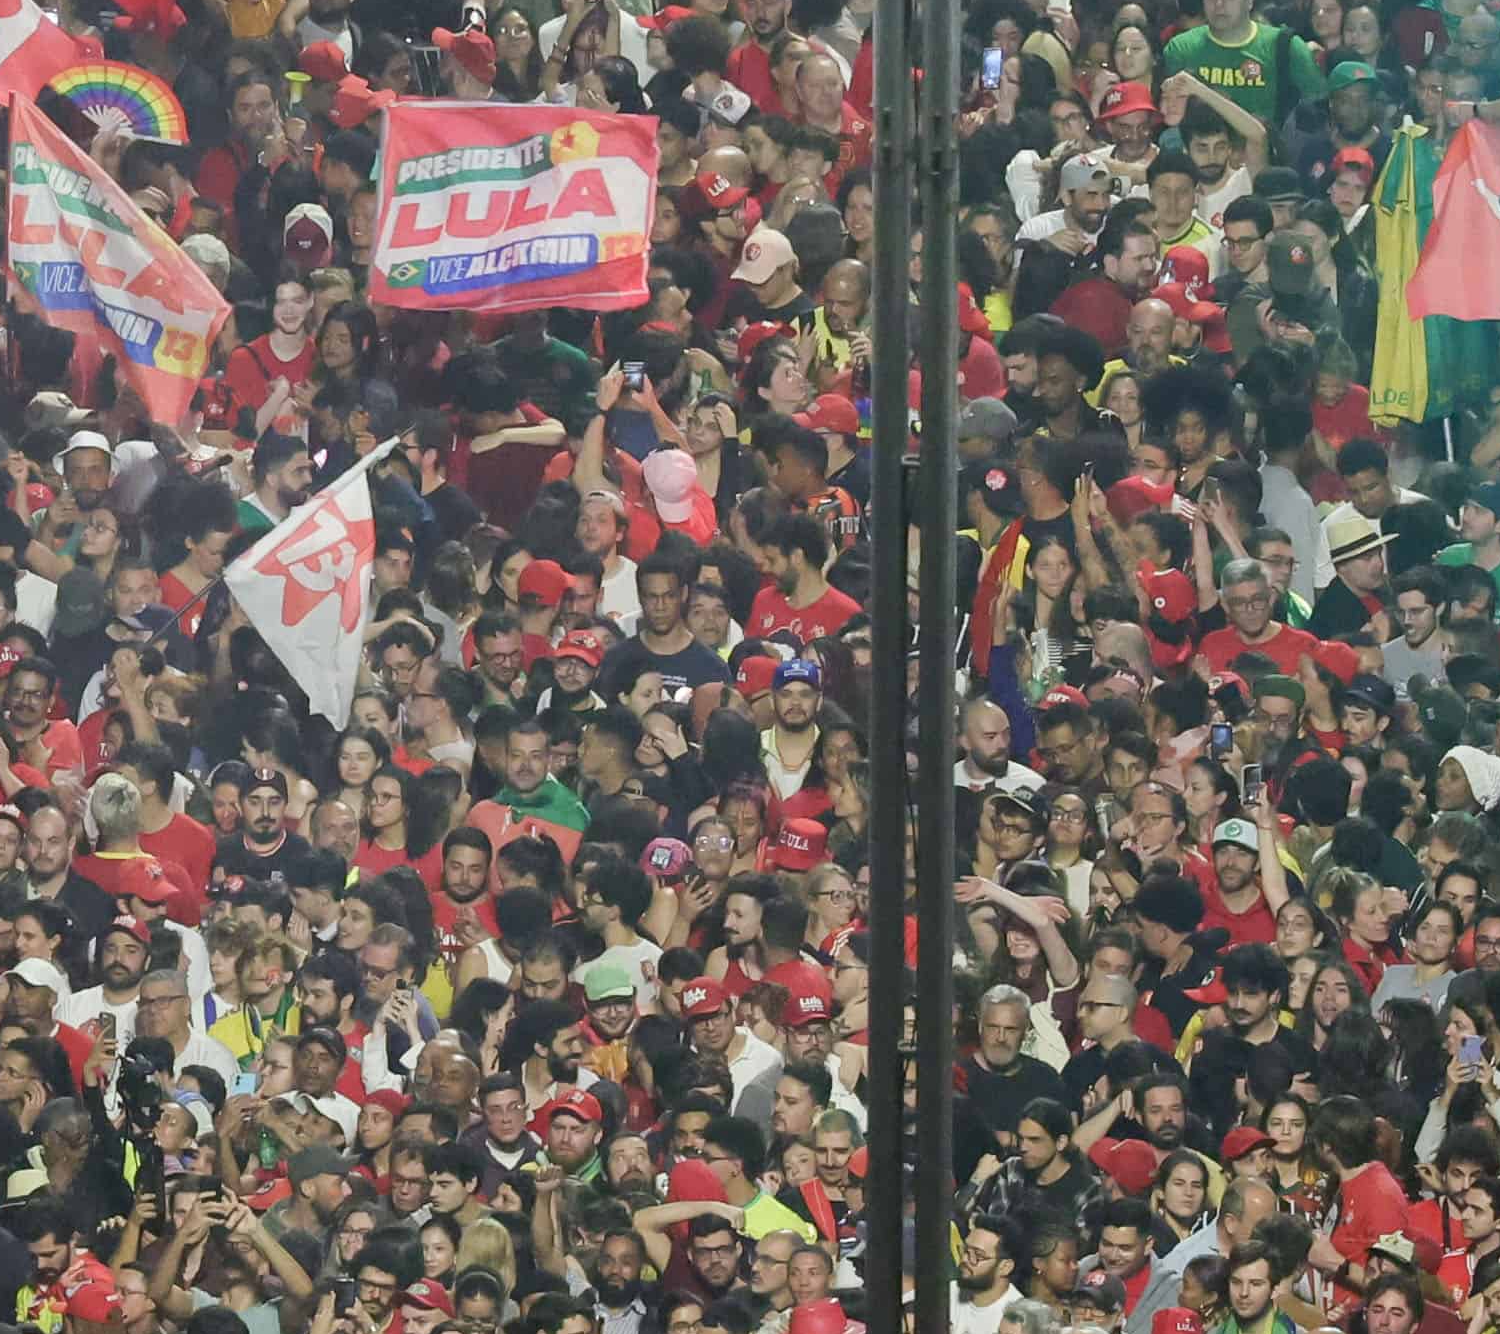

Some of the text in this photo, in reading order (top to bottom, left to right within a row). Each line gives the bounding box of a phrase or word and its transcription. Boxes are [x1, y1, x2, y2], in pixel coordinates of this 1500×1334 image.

[398, 135, 546, 183] PRESIDENTE
[389, 168, 617, 249] LULA
[43, 264, 77, 294] VICE
[428, 236, 591, 285] VICE ALCKMIN
[164, 330, 198, 361] 13
[276, 509, 356, 593] 13
